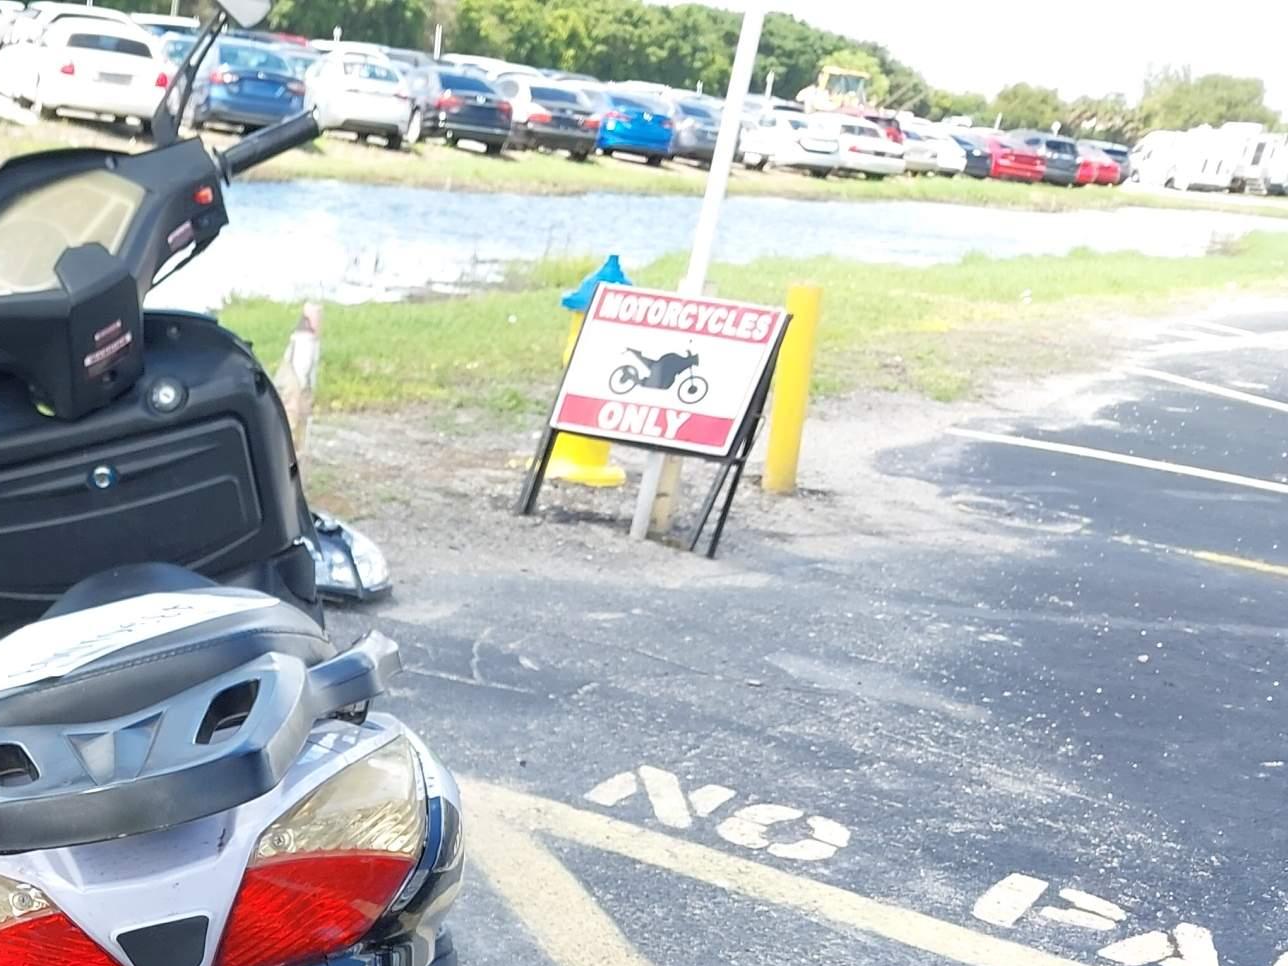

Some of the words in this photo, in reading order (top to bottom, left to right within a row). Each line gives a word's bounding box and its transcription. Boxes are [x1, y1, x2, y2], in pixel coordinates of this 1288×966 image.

[599, 292, 772, 341] MOTORCYCLES
[598, 404, 690, 439] ONLY
[583, 764, 852, 861] NO
